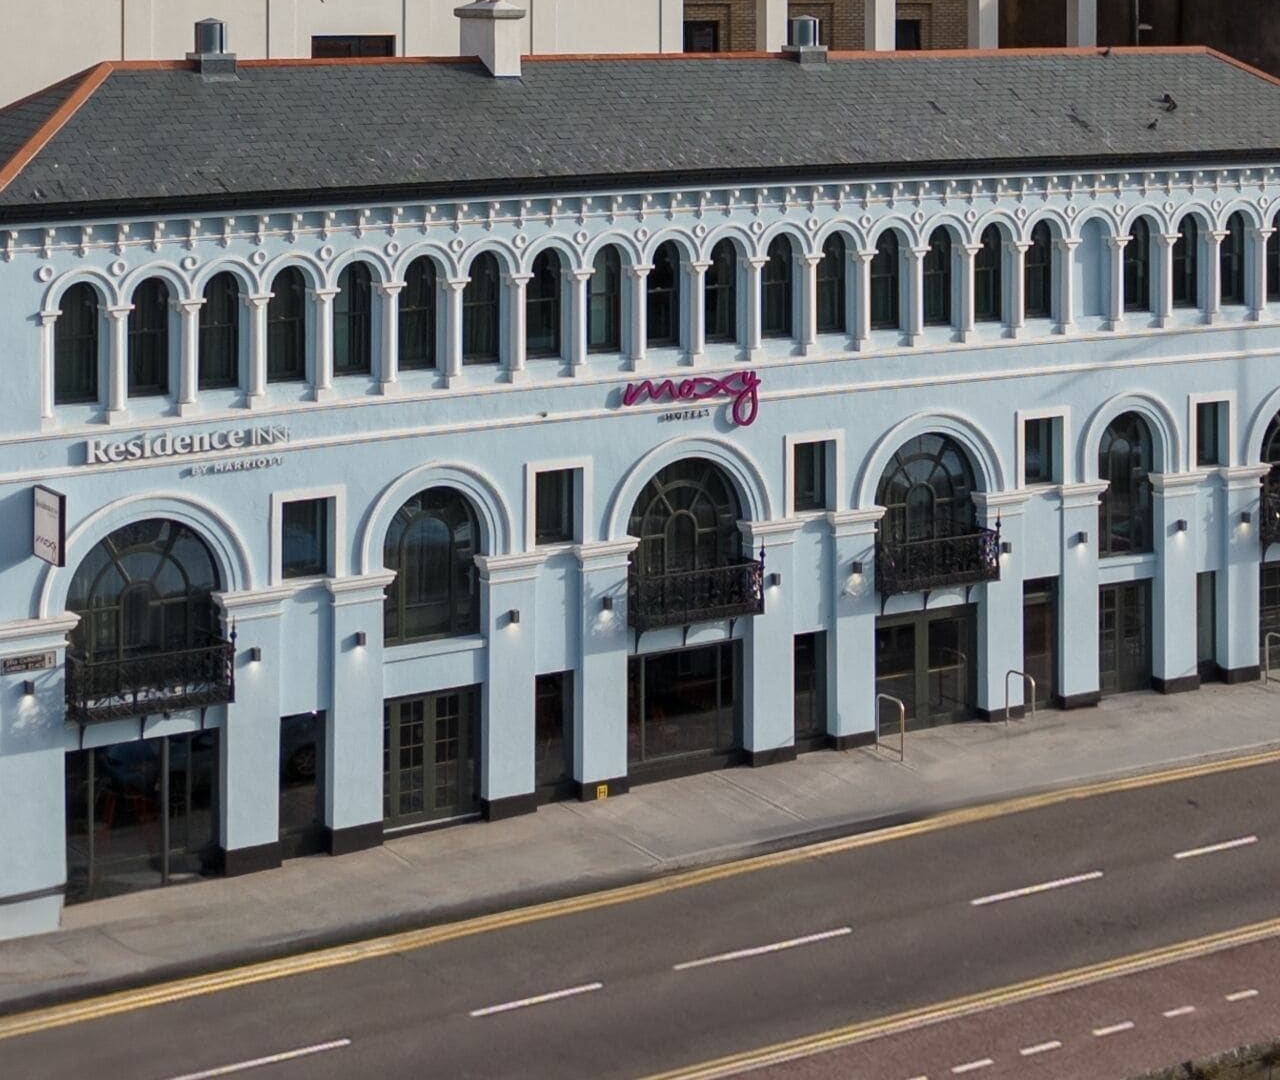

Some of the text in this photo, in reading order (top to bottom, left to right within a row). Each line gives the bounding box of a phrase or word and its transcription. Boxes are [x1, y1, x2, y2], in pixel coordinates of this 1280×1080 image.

[623, 371, 761, 426] moxy
[85, 425, 290, 464] Residence INN
[214, 456, 283, 473] MARRIOTT
